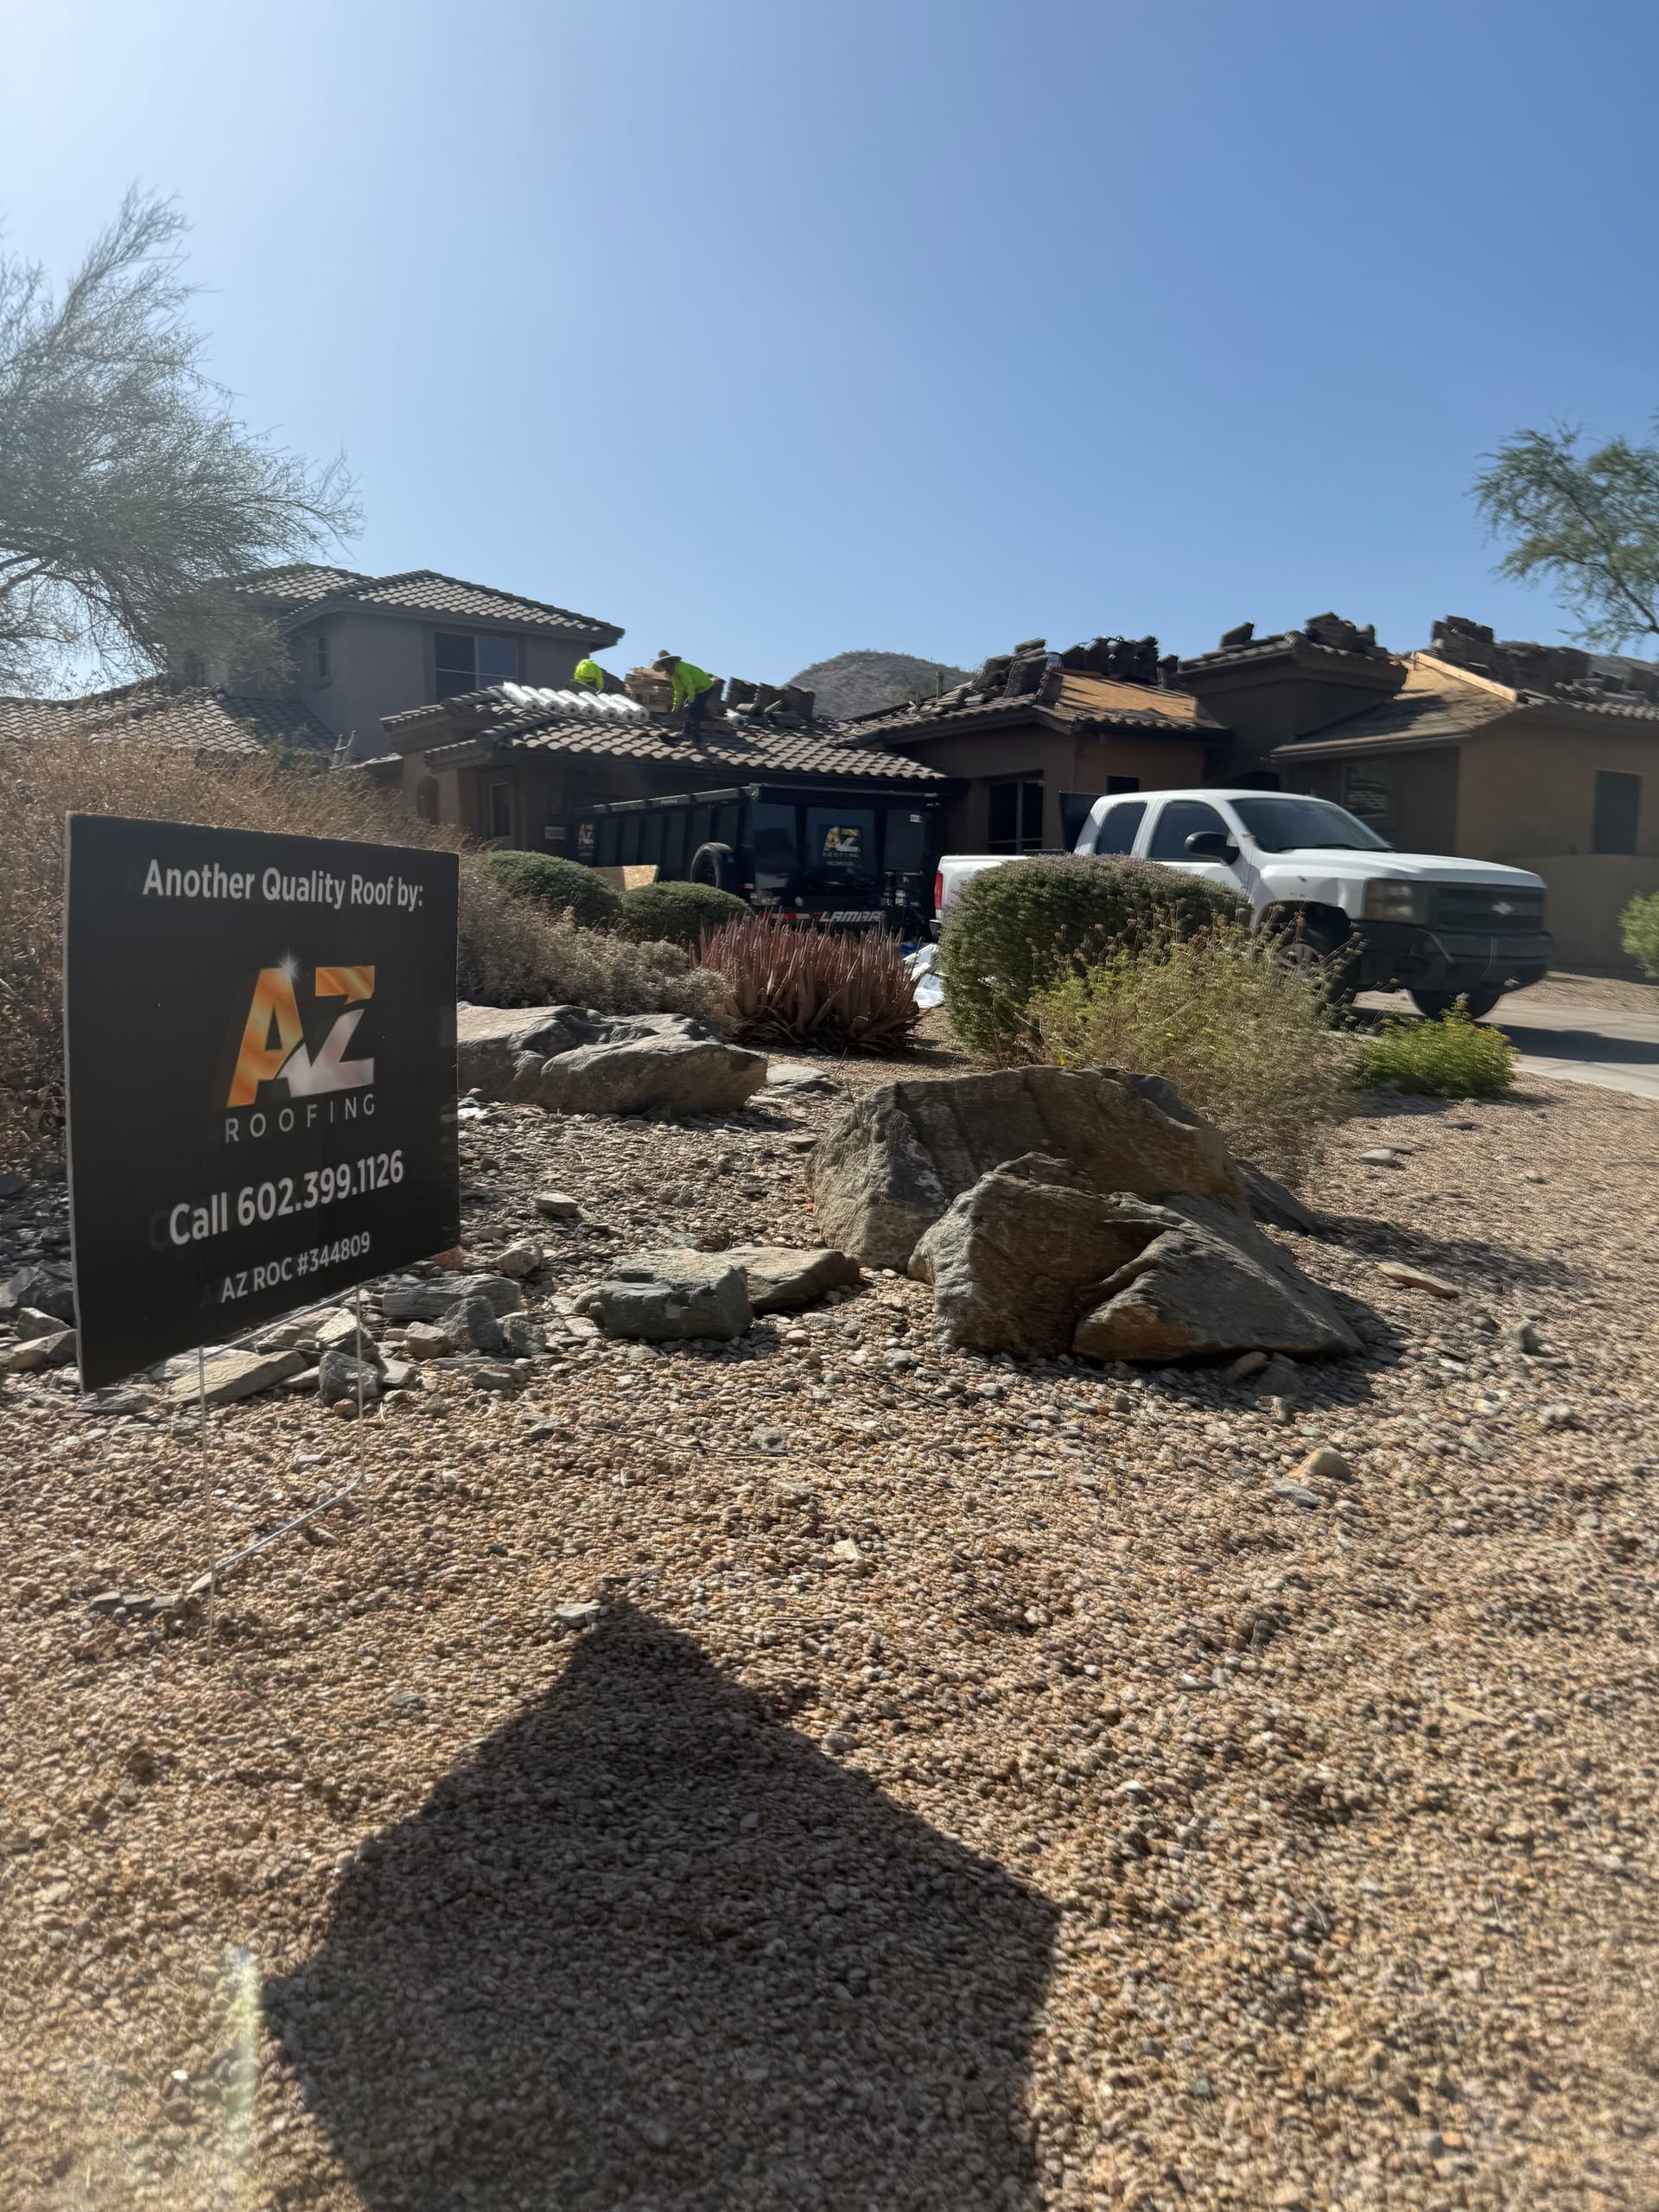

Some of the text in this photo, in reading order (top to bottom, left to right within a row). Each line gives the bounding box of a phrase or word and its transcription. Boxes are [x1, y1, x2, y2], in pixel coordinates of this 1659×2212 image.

[823, 827, 859, 852] AZ
[142, 858, 423, 912] Another Quality Roof by:
[226, 964, 375, 1109] AZ
[225, 1093, 375, 1143] ROOFING
[169, 1149, 404, 1245] Call 602.399.1126
[220, 1230, 371, 1303] AZ ROC #344809
